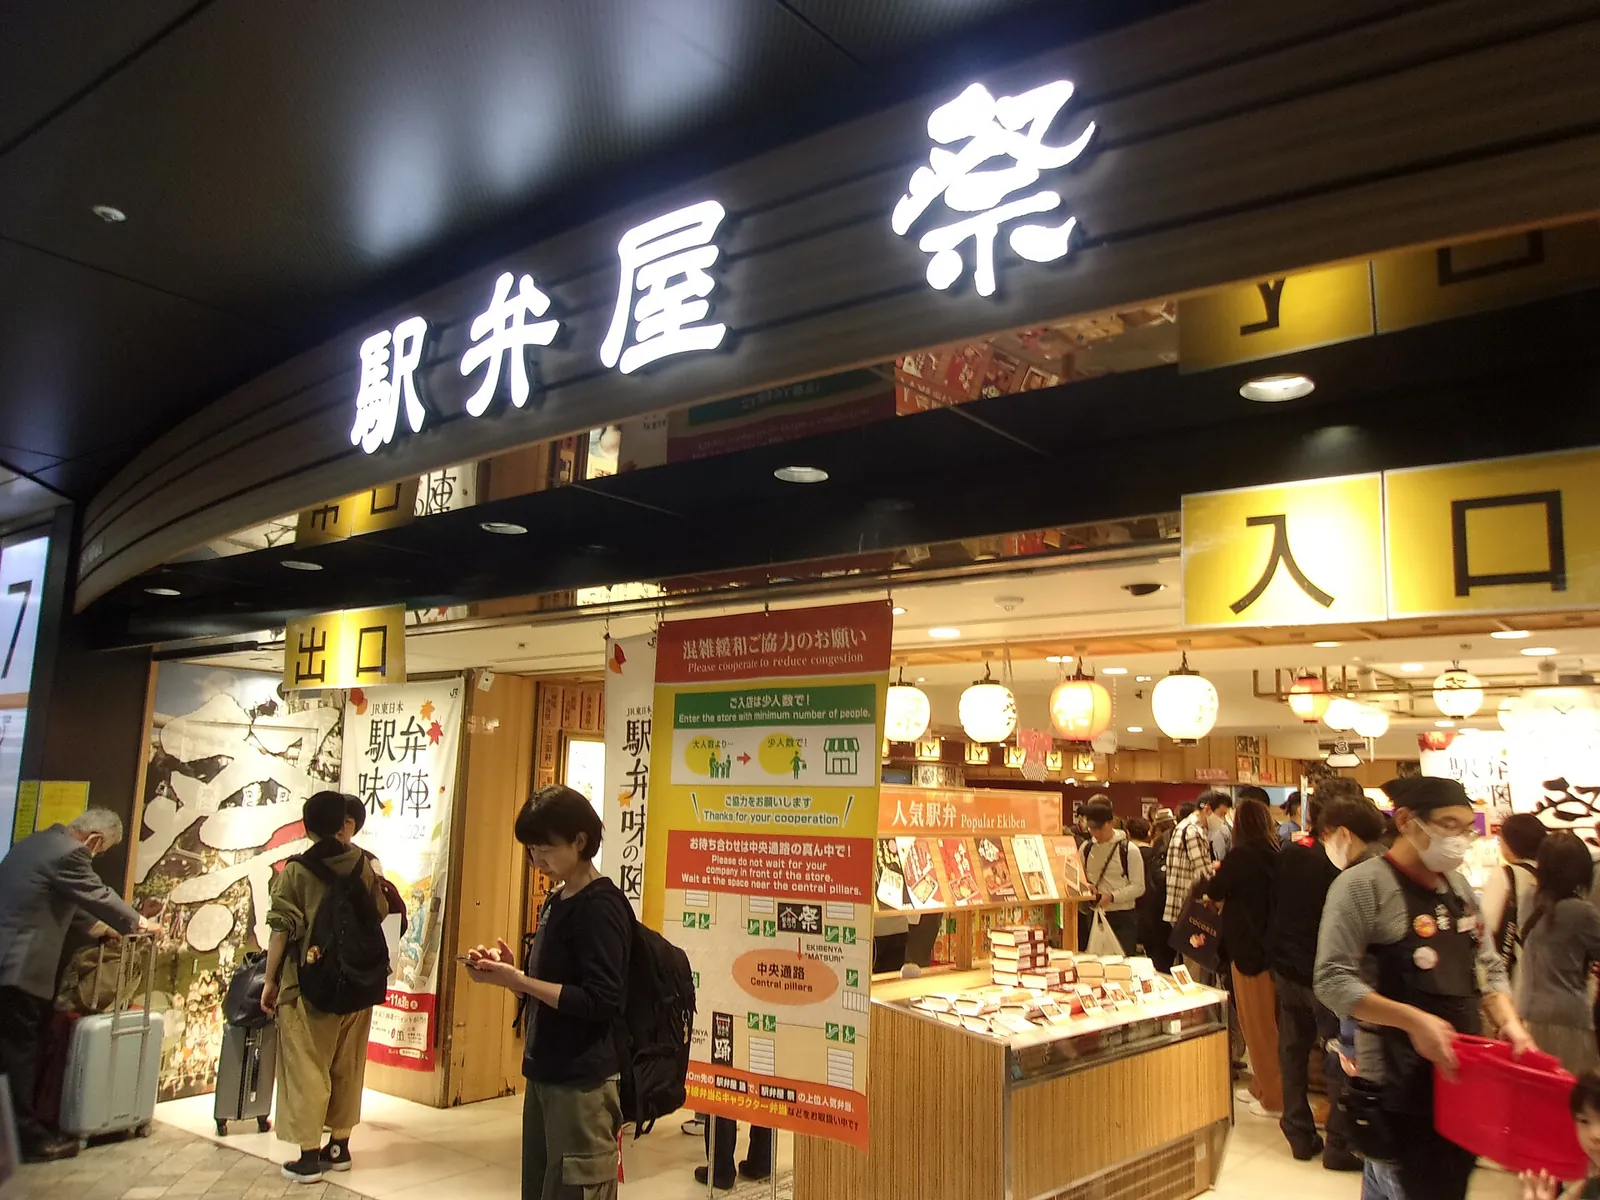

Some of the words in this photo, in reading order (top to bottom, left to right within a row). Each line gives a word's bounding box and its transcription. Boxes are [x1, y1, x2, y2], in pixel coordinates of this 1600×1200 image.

[350, 199, 727, 455] 駅弁屋
[891, 79, 1096, 297] 祭
[1230, 490, 1566, 614] 入口
[682, 627, 867, 660] 混雑緩和ご協力のお願い
[295, 626, 388, 685] 出口
[687, 662, 716, 673] Please
[718, 660, 759, 672] cooperate
[759, 658, 769, 667] to
[773, 655, 807, 667] reduce
[810, 652, 864, 666] congestion
[370, 701, 404, 716] JR東日本
[729, 694, 811, 709] ご入店は少人数で!
[678, 713, 700, 723] Enter
[701, 713, 715, 722] the
[716, 713, 737, 722] store
[738, 711, 753, 721] with
[753, 710, 790, 720] minimum
[792, 709, 826, 719] number
[828, 708, 838, 718] of
[840, 706, 871, 720] people.
[365, 715, 427, 765] 駅弁
[767, 737, 808, 748] 少人数で!
[358, 766, 431, 819] 味の陣
[725, 795, 812, 809] ご協力をお願いします
[703, 810, 734, 821] Thanks
[735, 810, 748, 822] for
[750, 814, 771, 824] your
[774, 813, 839, 826] cooperation
[891, 800, 957, 828] 人気駅弁
[960, 813, 995, 831] Popular
[997, 814, 1026, 830] Ekiben
[689, 837, 851, 858] お待ち合わせは中央通路の真ん中で!
[711, 854, 737, 866] Please
[738, 856, 748, 867] do
[749, 857, 763, 868] not
[765, 858, 785, 869] wait
[788, 859, 803, 870] for
[805, 862, 828, 872] your
[681, 872, 700, 884] Wait
[701, 874, 711, 884] at
[713, 874, 726, 886] the
[728, 877, 749, 888] space
[751, 879, 771, 889] near
[773, 880, 789, 891] the
[791, 881, 827, 893] central
[829, 883, 862, 896] pillars.
[706, 866, 739, 877] company
[740, 867, 748, 877] in
[749, 868, 771, 879] front
[773, 869, 783, 879] of
[785, 870, 802, 881] the
[805, 872, 834, 883] store.
[806, 944, 843, 954] EKIBENYA
[757, 962, 806, 981] 中央通路
[750, 977, 782, 990] Central
[784, 981, 813, 993] pillars
